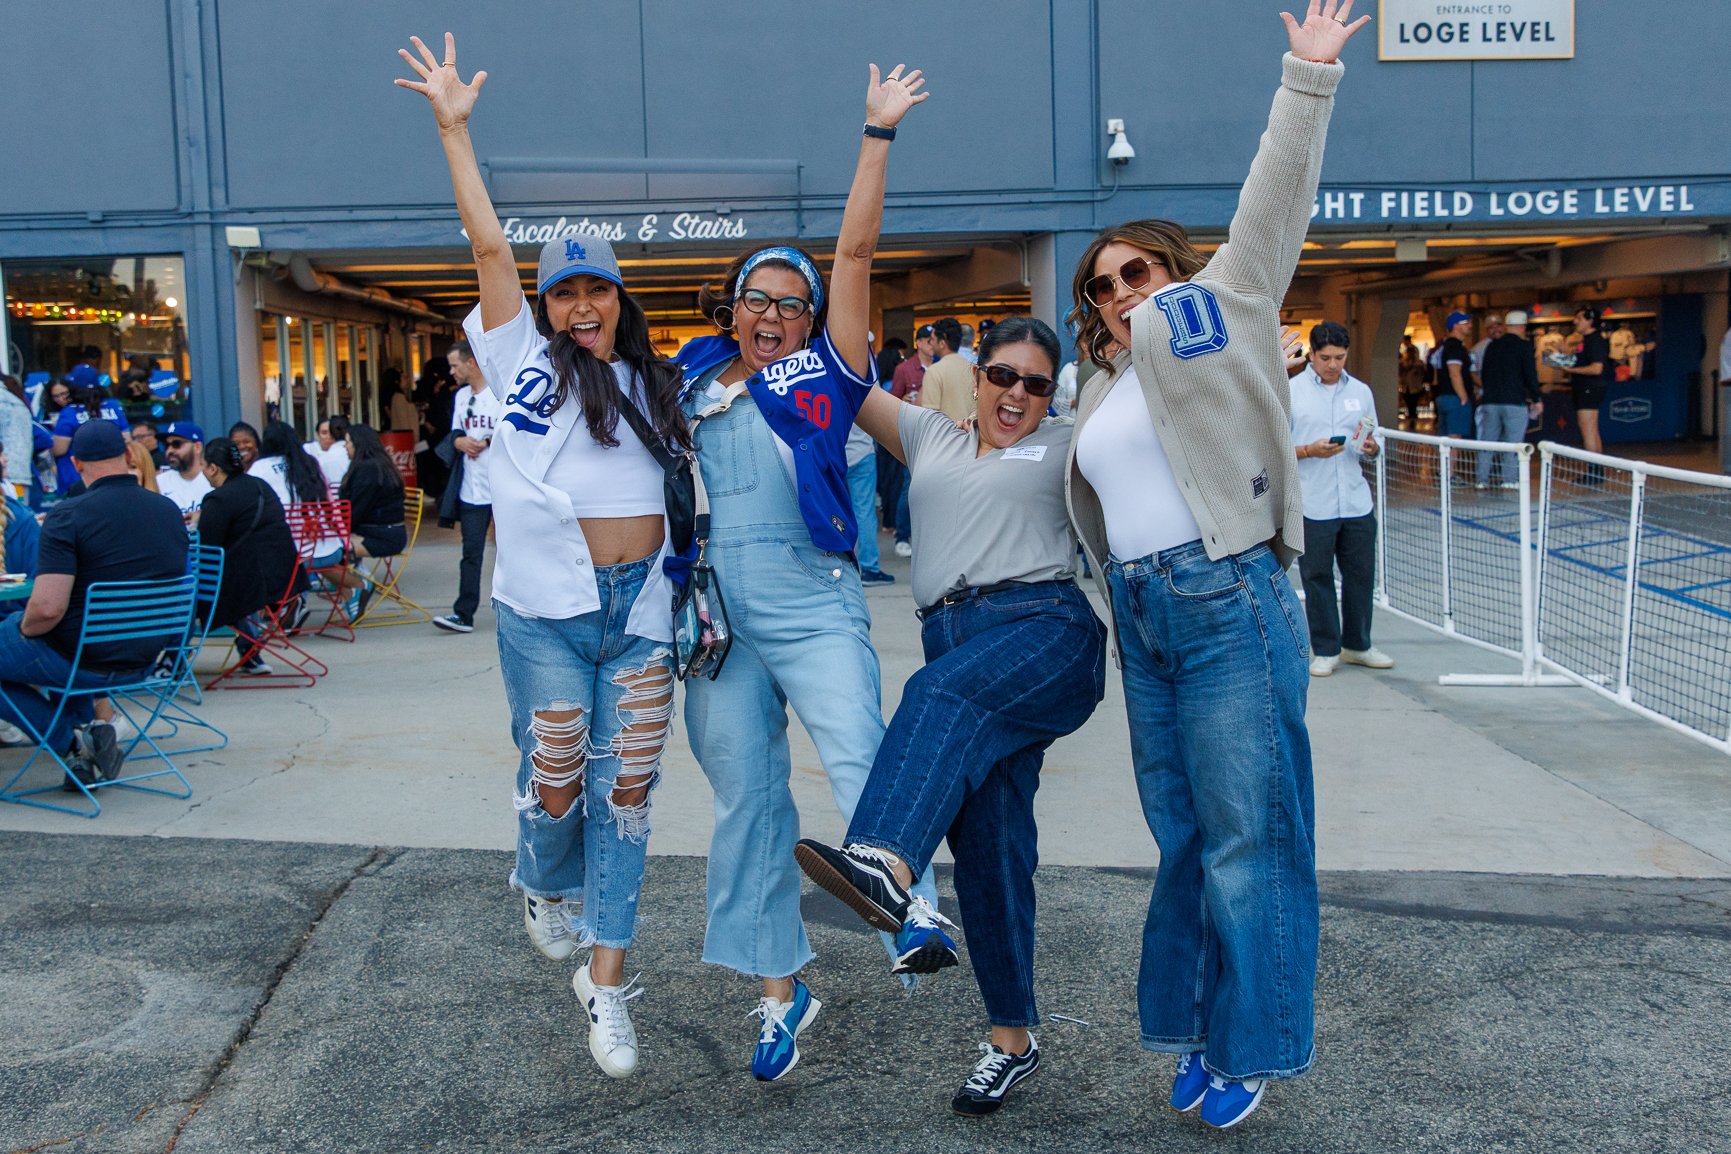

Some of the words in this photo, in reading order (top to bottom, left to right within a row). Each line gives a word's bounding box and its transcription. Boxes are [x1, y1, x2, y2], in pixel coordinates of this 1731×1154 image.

[1436, 5, 1494, 15] ENTRANCE
[1498, 4, 1512, 14] TO
[1399, 22, 1470, 44] LOGE
[1482, 21, 1555, 43] LEVEL
[1381, 191, 1473, 218] FIELD
[1490, 189, 1579, 216] LOGE
[1595, 185, 1694, 213] LEVEL
[502, 216, 627, 244] Escalators
[638, 214, 658, 241] &
[668, 213, 747, 240] Stairs
[565, 239, 586, 261] LA
[794, 389, 831, 431] 50
